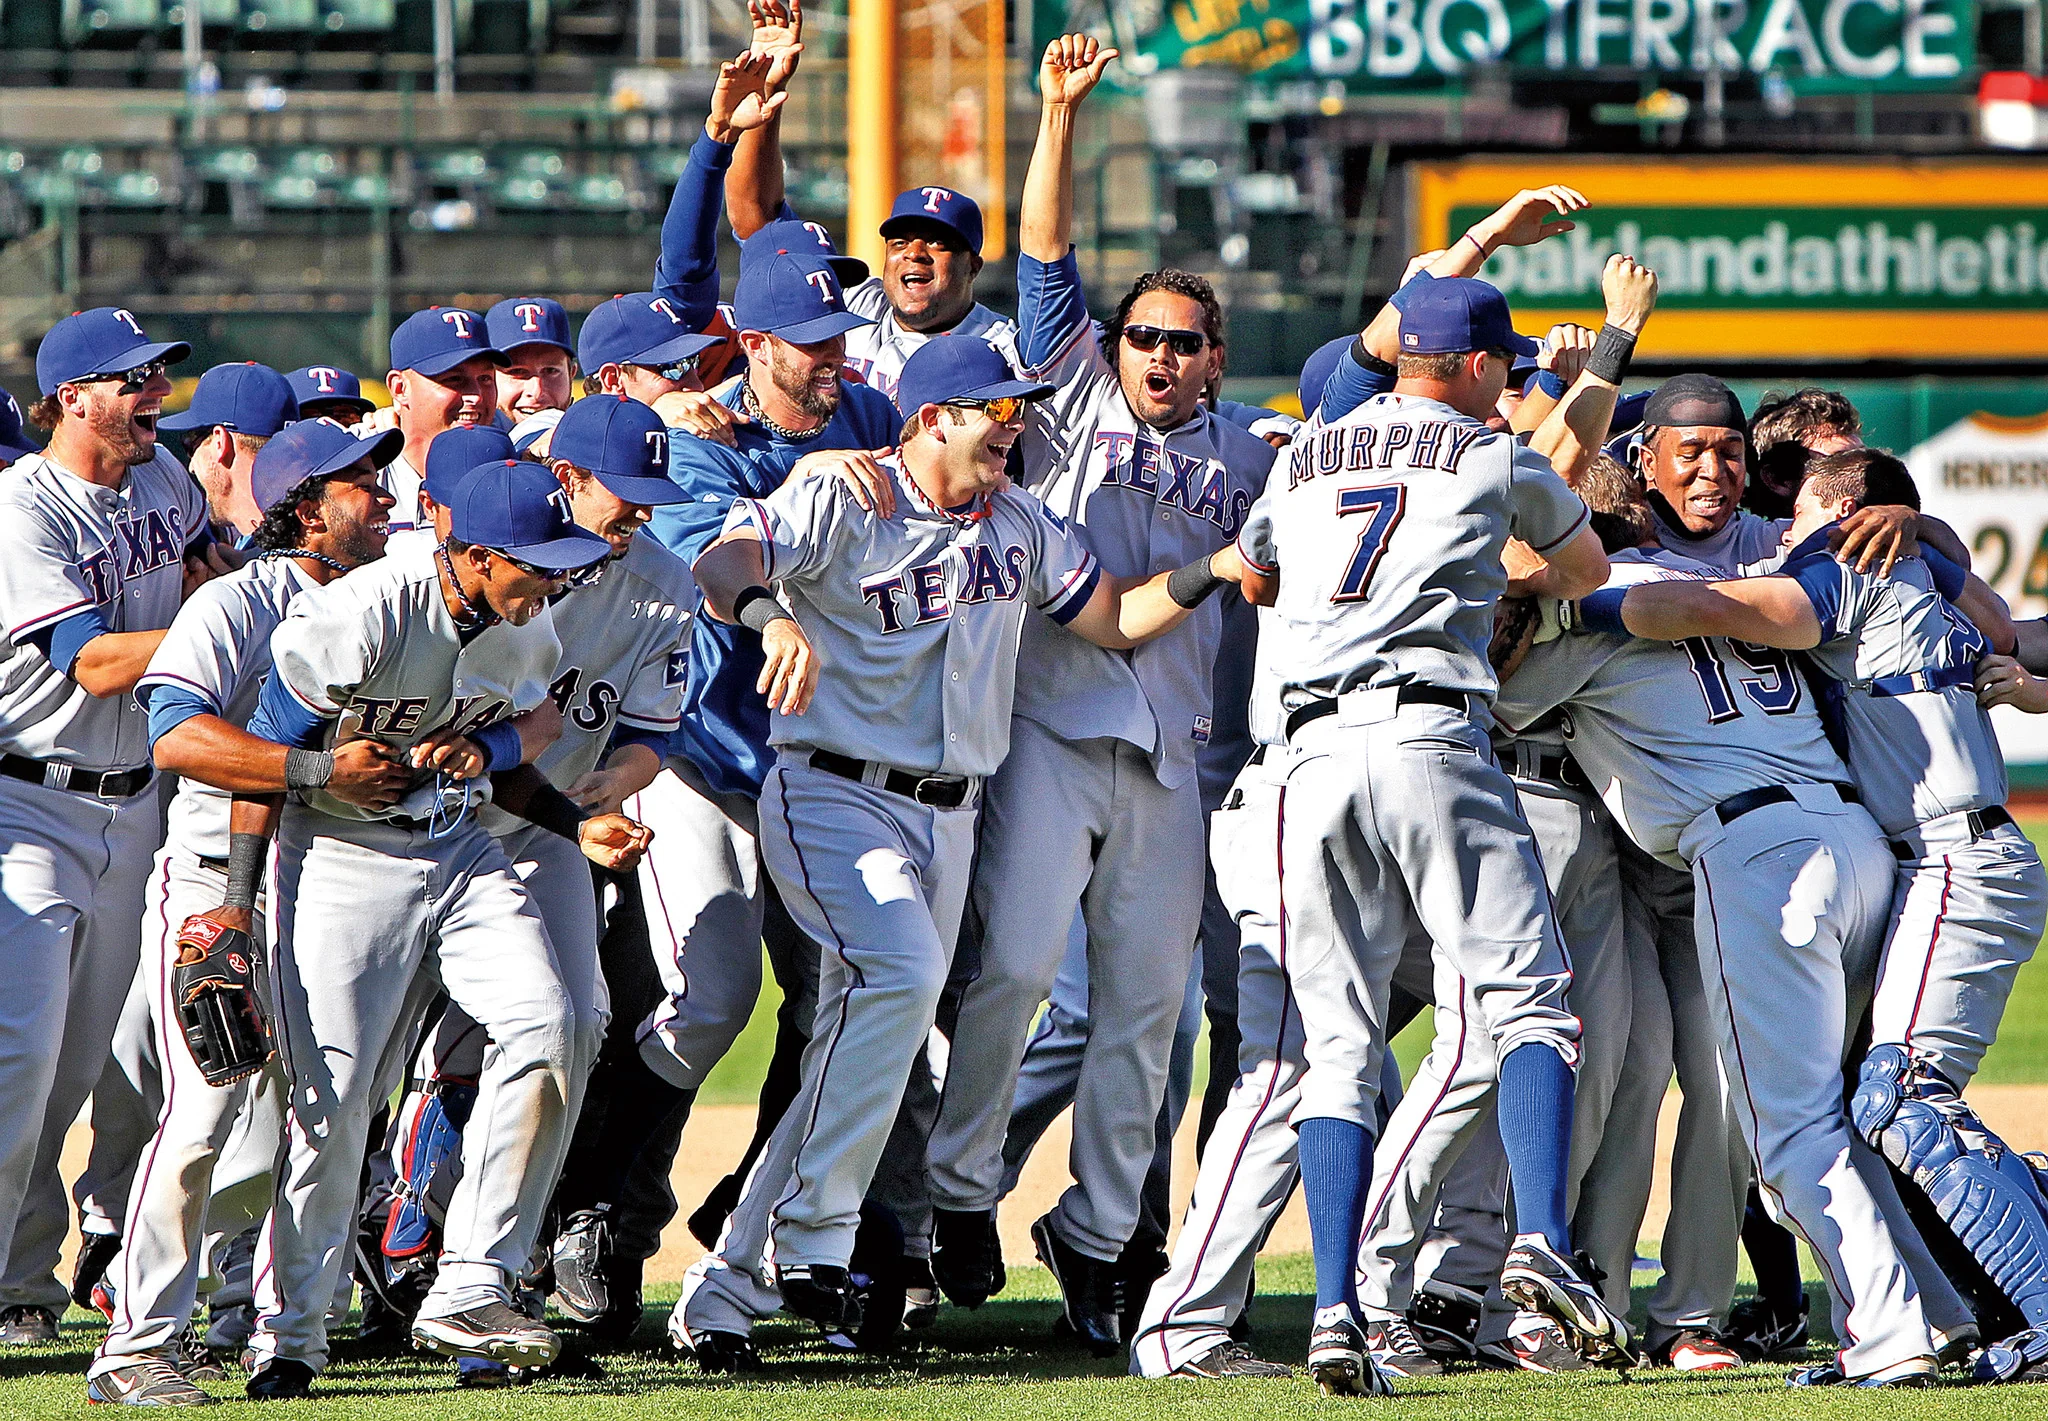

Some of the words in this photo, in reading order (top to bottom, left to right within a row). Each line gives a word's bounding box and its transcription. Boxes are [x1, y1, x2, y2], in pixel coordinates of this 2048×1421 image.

[1308, 0, 1511, 77] BBQ
[920, 187, 952, 213] T
[802, 221, 831, 247] T
[805, 270, 836, 304] T
[112, 309, 145, 336] T
[441, 311, 472, 338] T
[513, 303, 546, 332] T
[648, 297, 683, 325] T
[307, 367, 340, 393] T
[645, 431, 667, 467] T
[1288, 420, 1478, 492] MURPHY
[1094, 431, 1250, 542] TEXAS
[545, 487, 571, 524] T
[1330, 482, 1408, 605] 7
[858, 543, 1028, 635] TEXAS
[1670, 635, 1802, 725] 19
